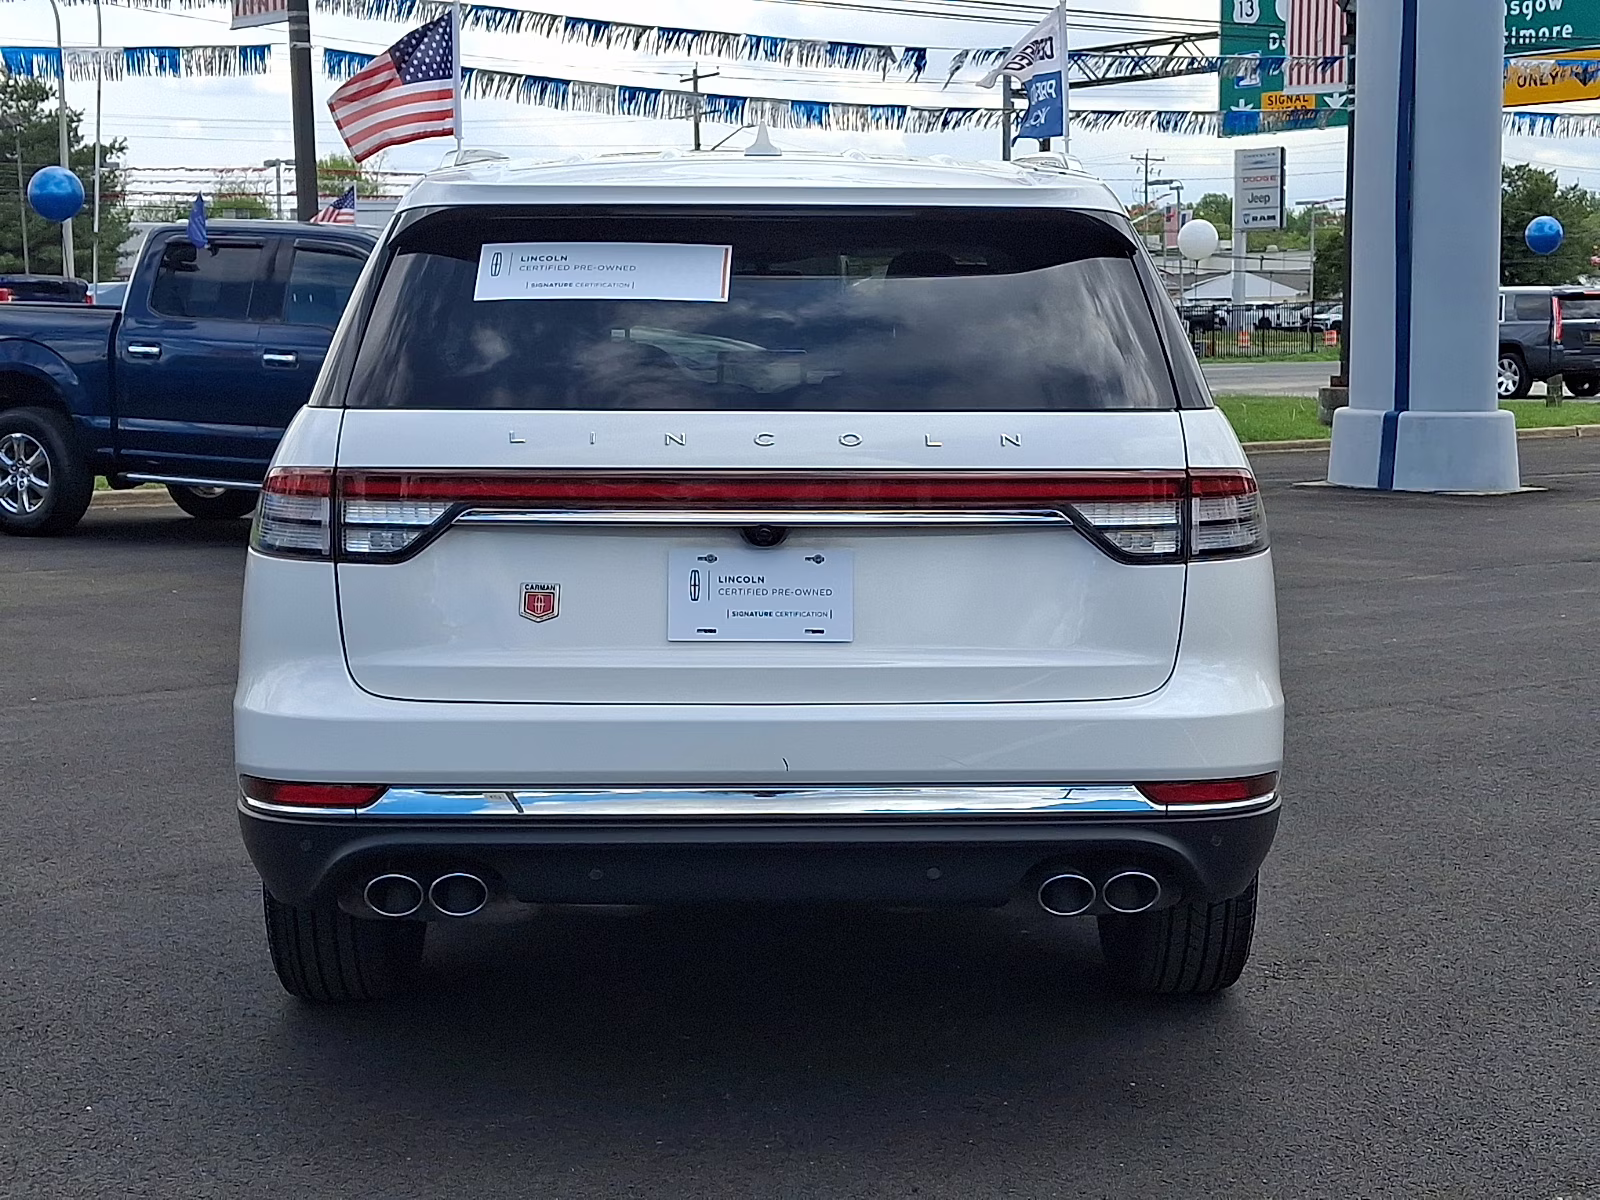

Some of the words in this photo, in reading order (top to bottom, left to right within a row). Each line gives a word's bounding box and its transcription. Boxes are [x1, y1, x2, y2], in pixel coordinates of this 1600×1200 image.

[1239, 0, 1254, 18] 13
[1504, 0, 1562, 20] sgow
[1517, 72, 1559, 88] ONLY
[1267, 95, 1308, 106] SIGNAL
[1243, 175, 1277, 183] DODGE
[1248, 193, 1270, 204] Jeep
[509, 430, 1021, 447] LINCOLN
[718, 576, 765, 584] LINCOLN
[718, 588, 769, 596] CERTIFIED
[772, 588, 833, 596] PRE-OWNED
